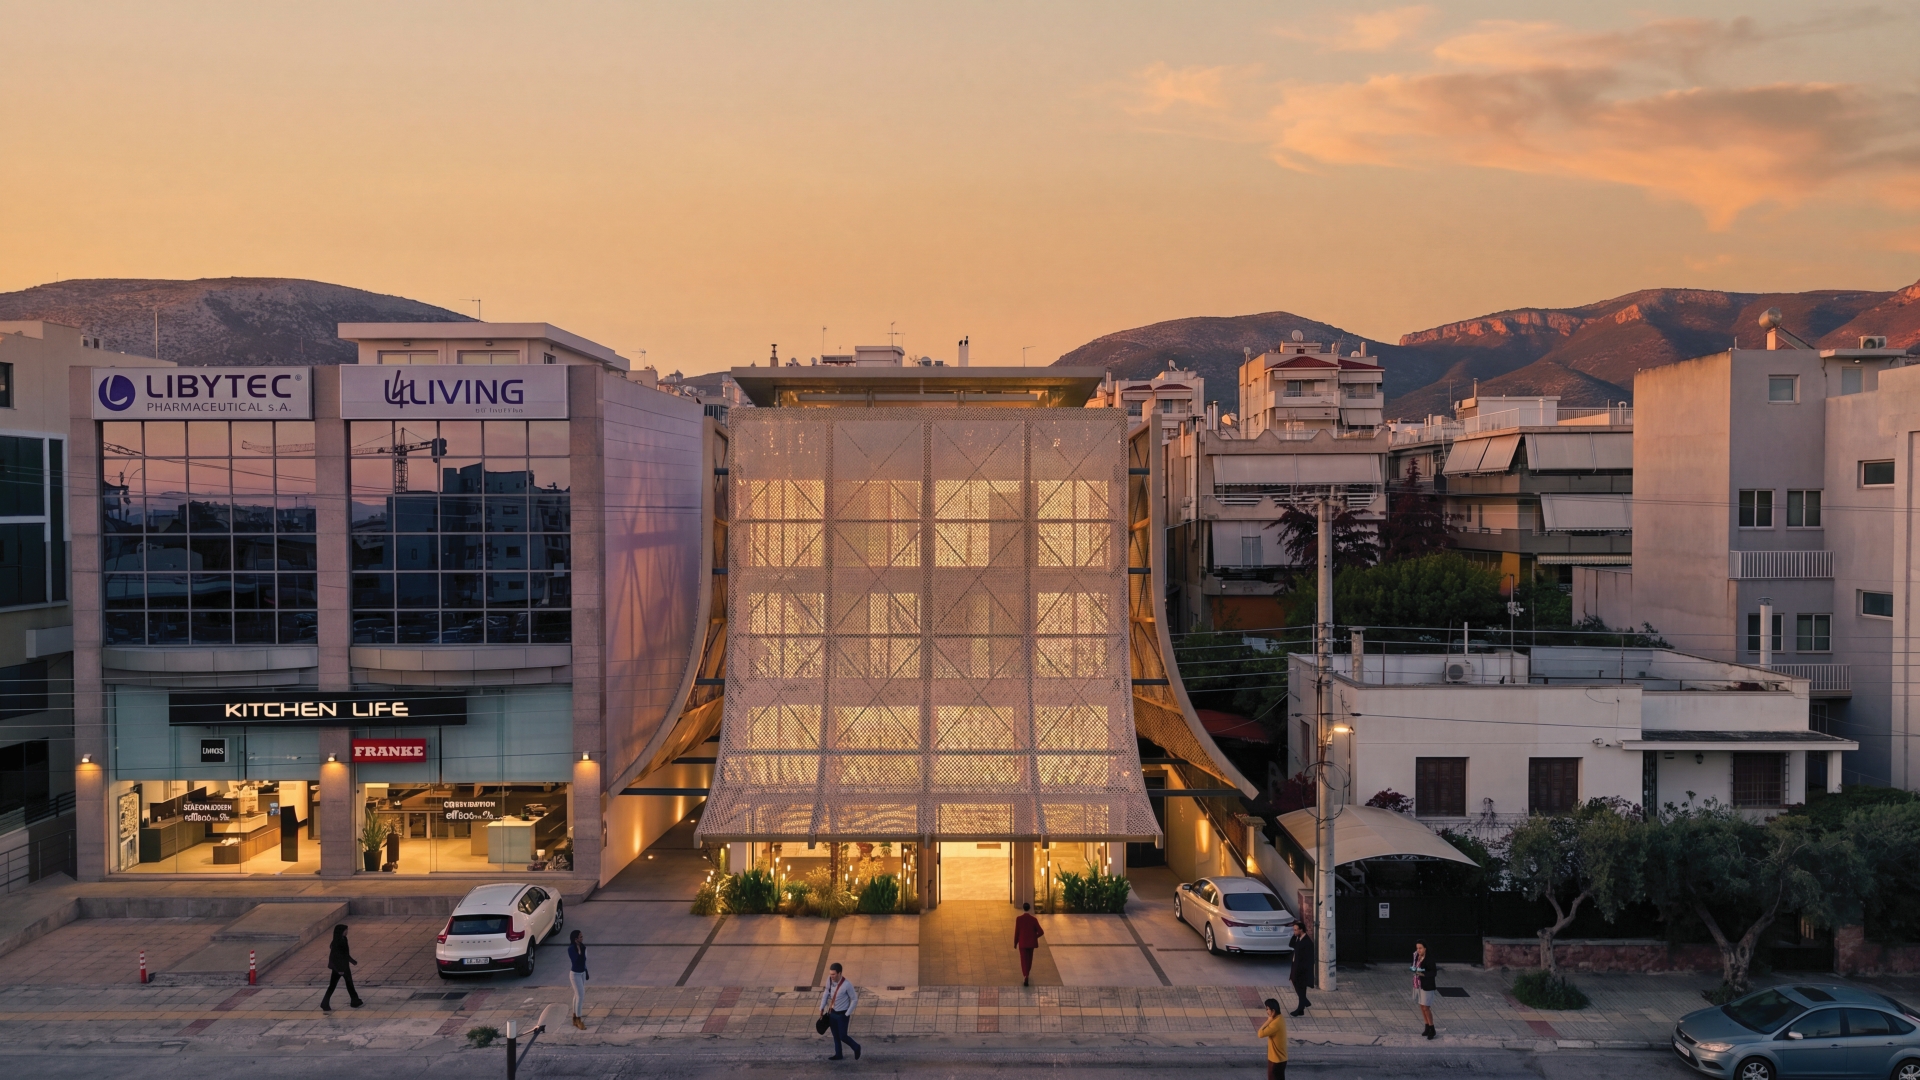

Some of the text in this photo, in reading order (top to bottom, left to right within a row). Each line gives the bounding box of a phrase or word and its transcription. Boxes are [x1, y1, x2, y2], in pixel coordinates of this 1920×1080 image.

[146, 374, 292, 399] LIBYTEC
[146, 402, 263, 412] PHARMACEUTICAL
[225, 702, 409, 718] KITCHEN LIFE
[354, 746, 424, 757] FRANKE
